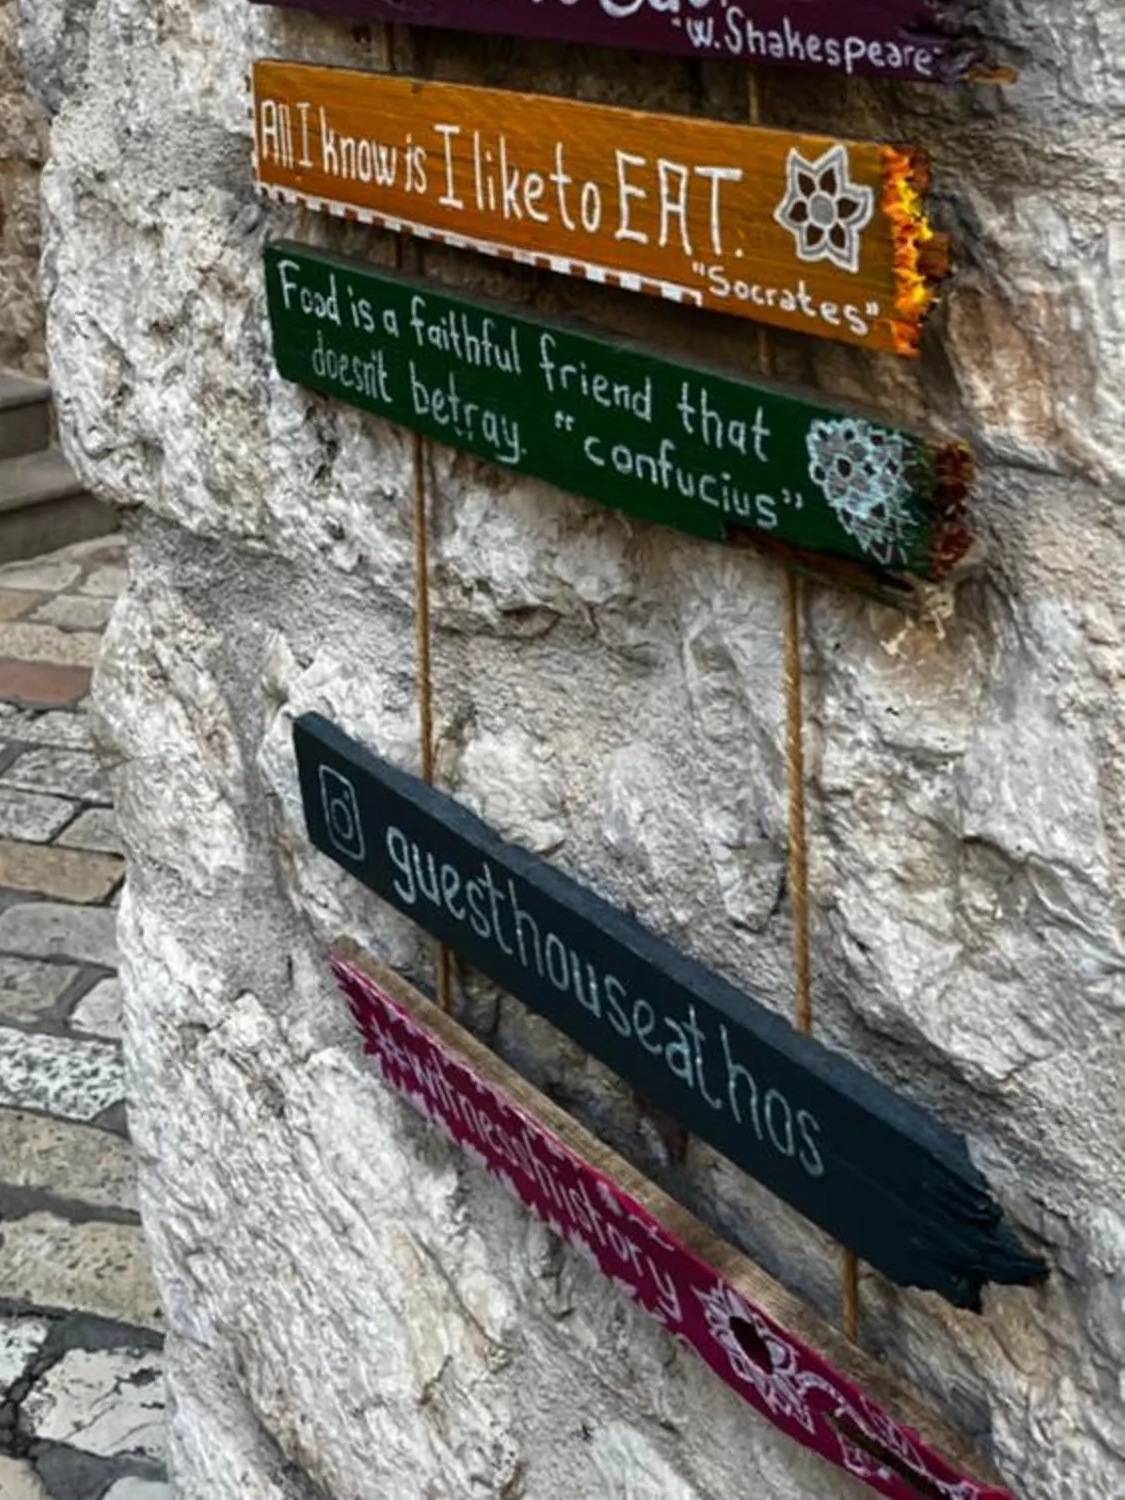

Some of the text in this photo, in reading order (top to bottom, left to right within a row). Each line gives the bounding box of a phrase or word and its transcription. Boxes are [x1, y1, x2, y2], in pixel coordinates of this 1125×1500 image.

[297, 102, 315, 169] I
[319, 107, 401, 192] know
[403, 134, 429, 195] is
[433, 124, 465, 211] I
[473, 131, 551, 224] like
[549, 143, 603, 235] to
[613, 149, 745, 260] EAT.
[277, 259, 771, 463] Food is a faithful friend that
[386, 825, 825, 1178] guesthouseathos
